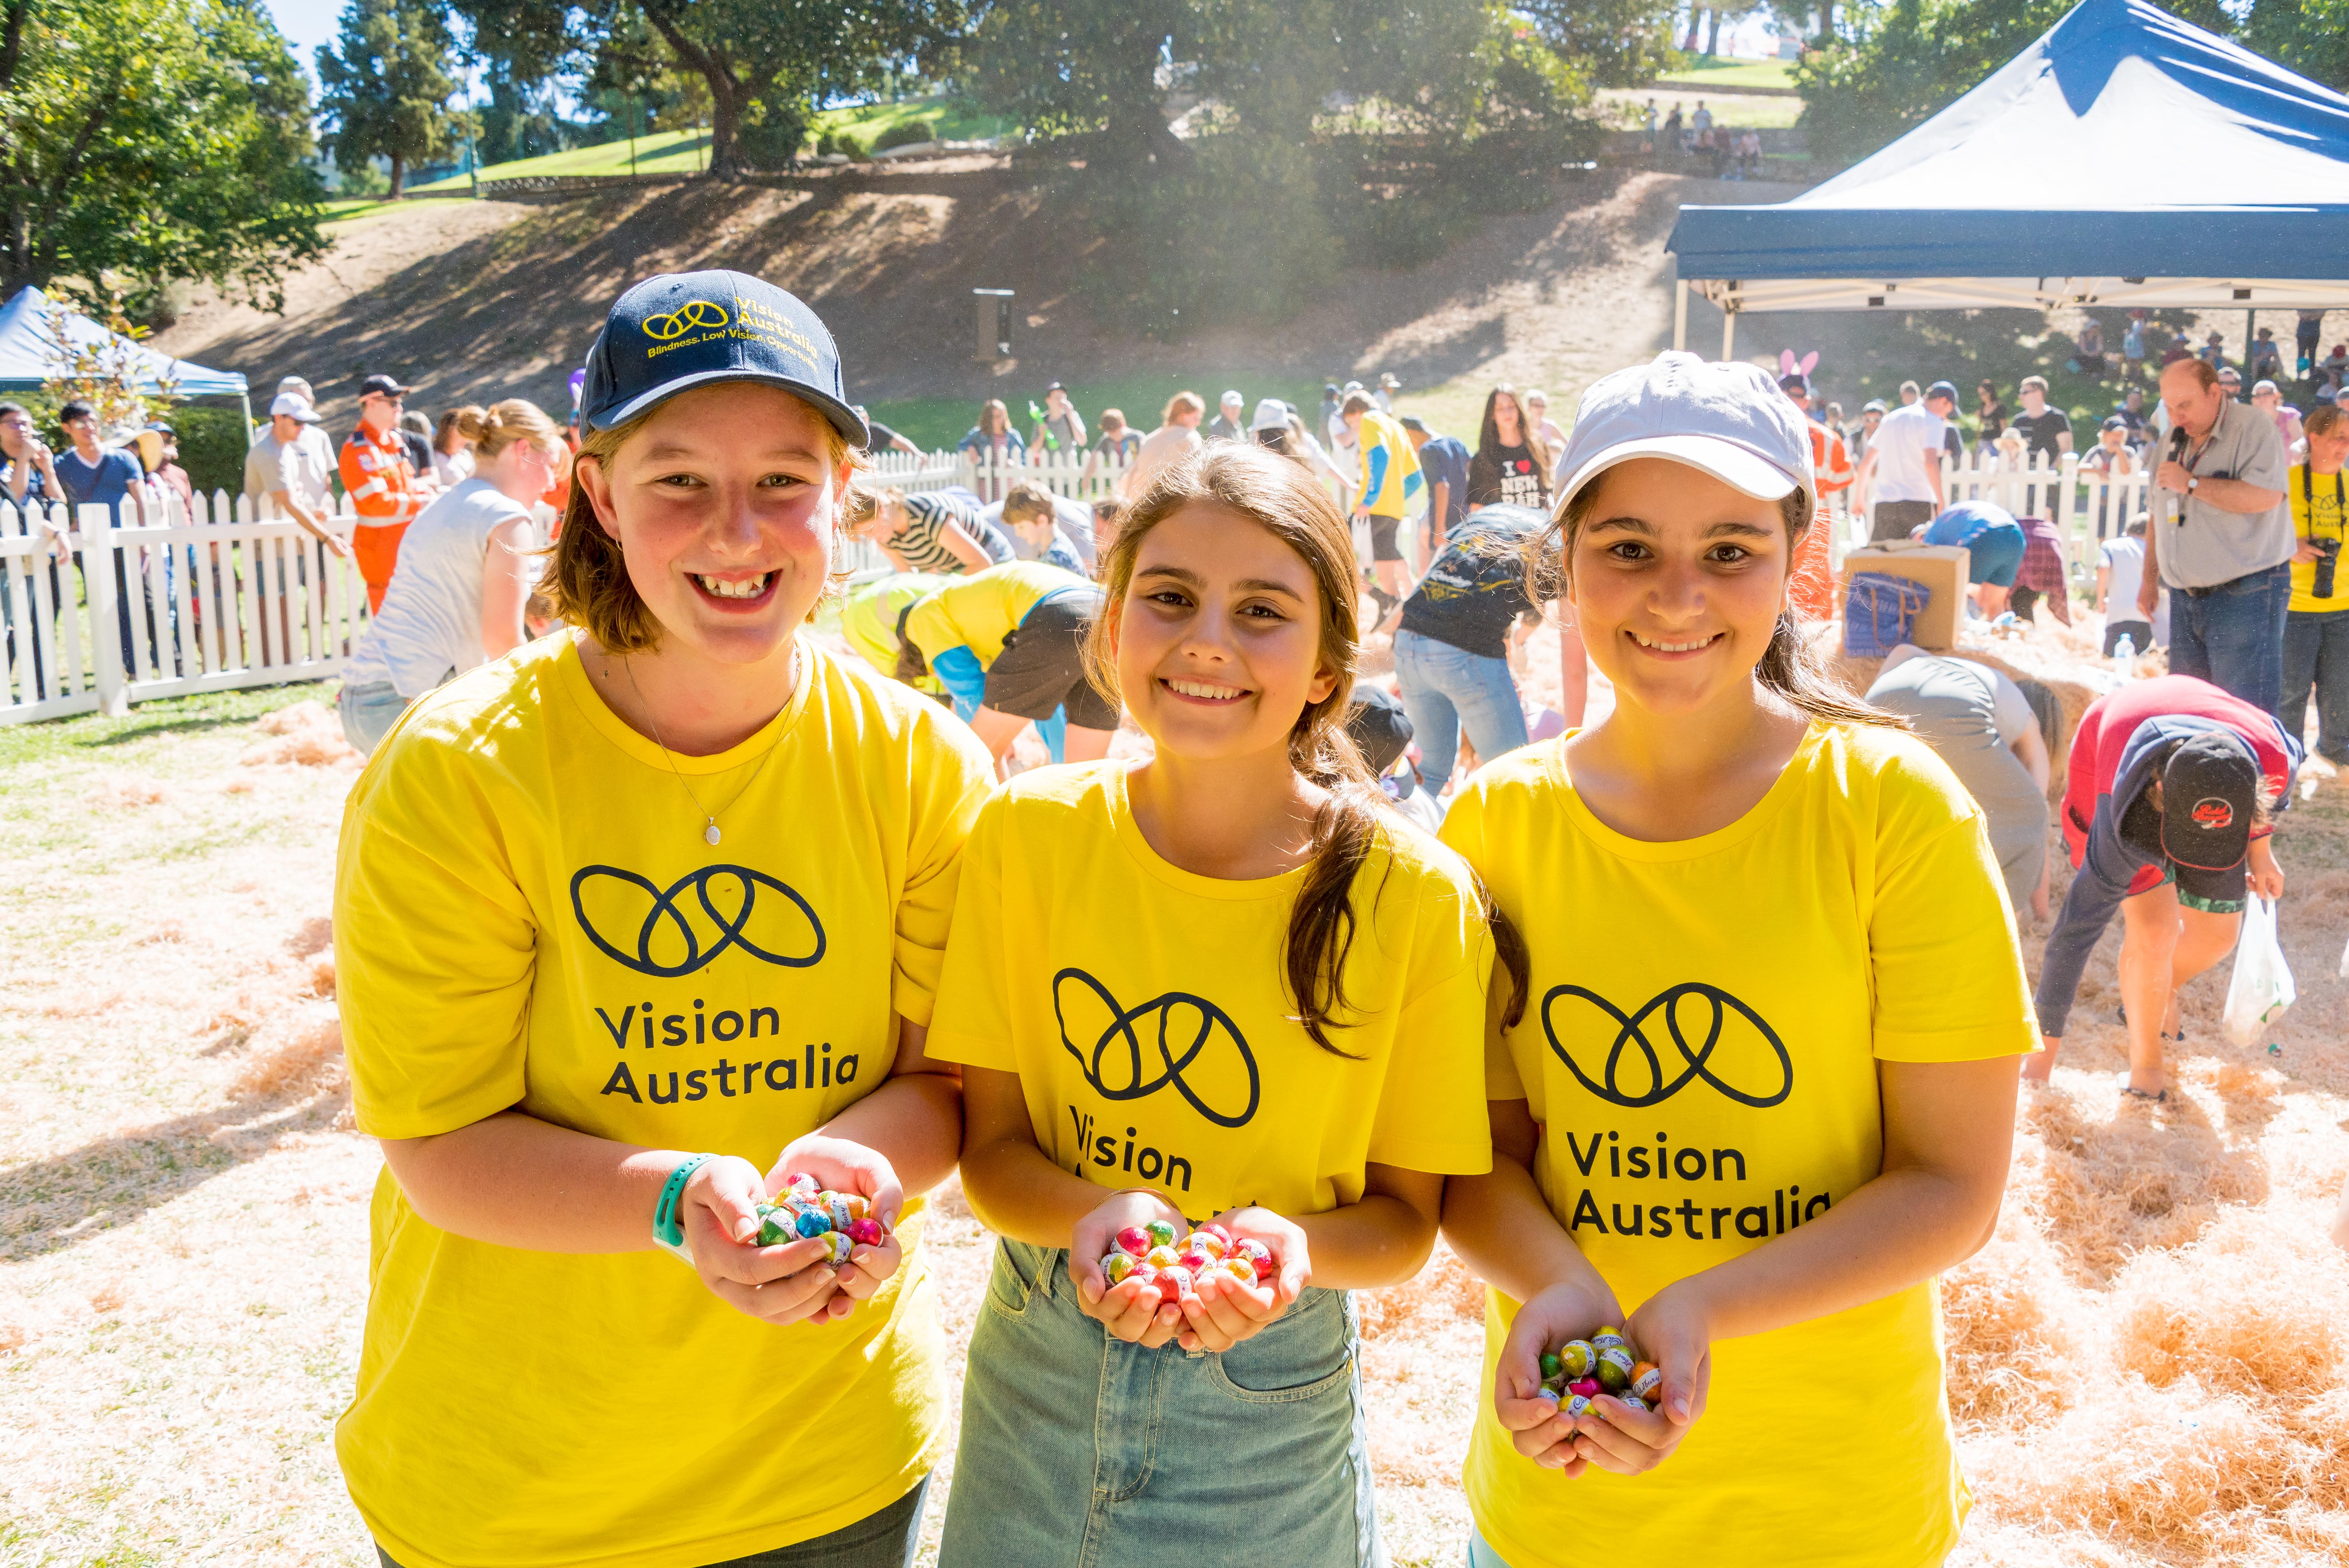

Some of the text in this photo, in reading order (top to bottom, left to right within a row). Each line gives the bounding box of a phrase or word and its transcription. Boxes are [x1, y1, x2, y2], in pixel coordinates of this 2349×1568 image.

[735, 296, 794, 329] Vision
[647, 337, 701, 358] Blindness.
[703, 330, 726, 342] Low
[737, 310, 818, 361] Australia
[1502, 460, 1517, 477] I
[594, 999, 779, 1049] Vision
[600, 1043, 859, 1104] Australia
[1069, 1105, 1192, 1192] Vision
[1566, 1131, 1746, 1181] Vision
[841, 1207, 849, 1226] dbury
[1634, 1376, 1660, 1397] Cadbury
